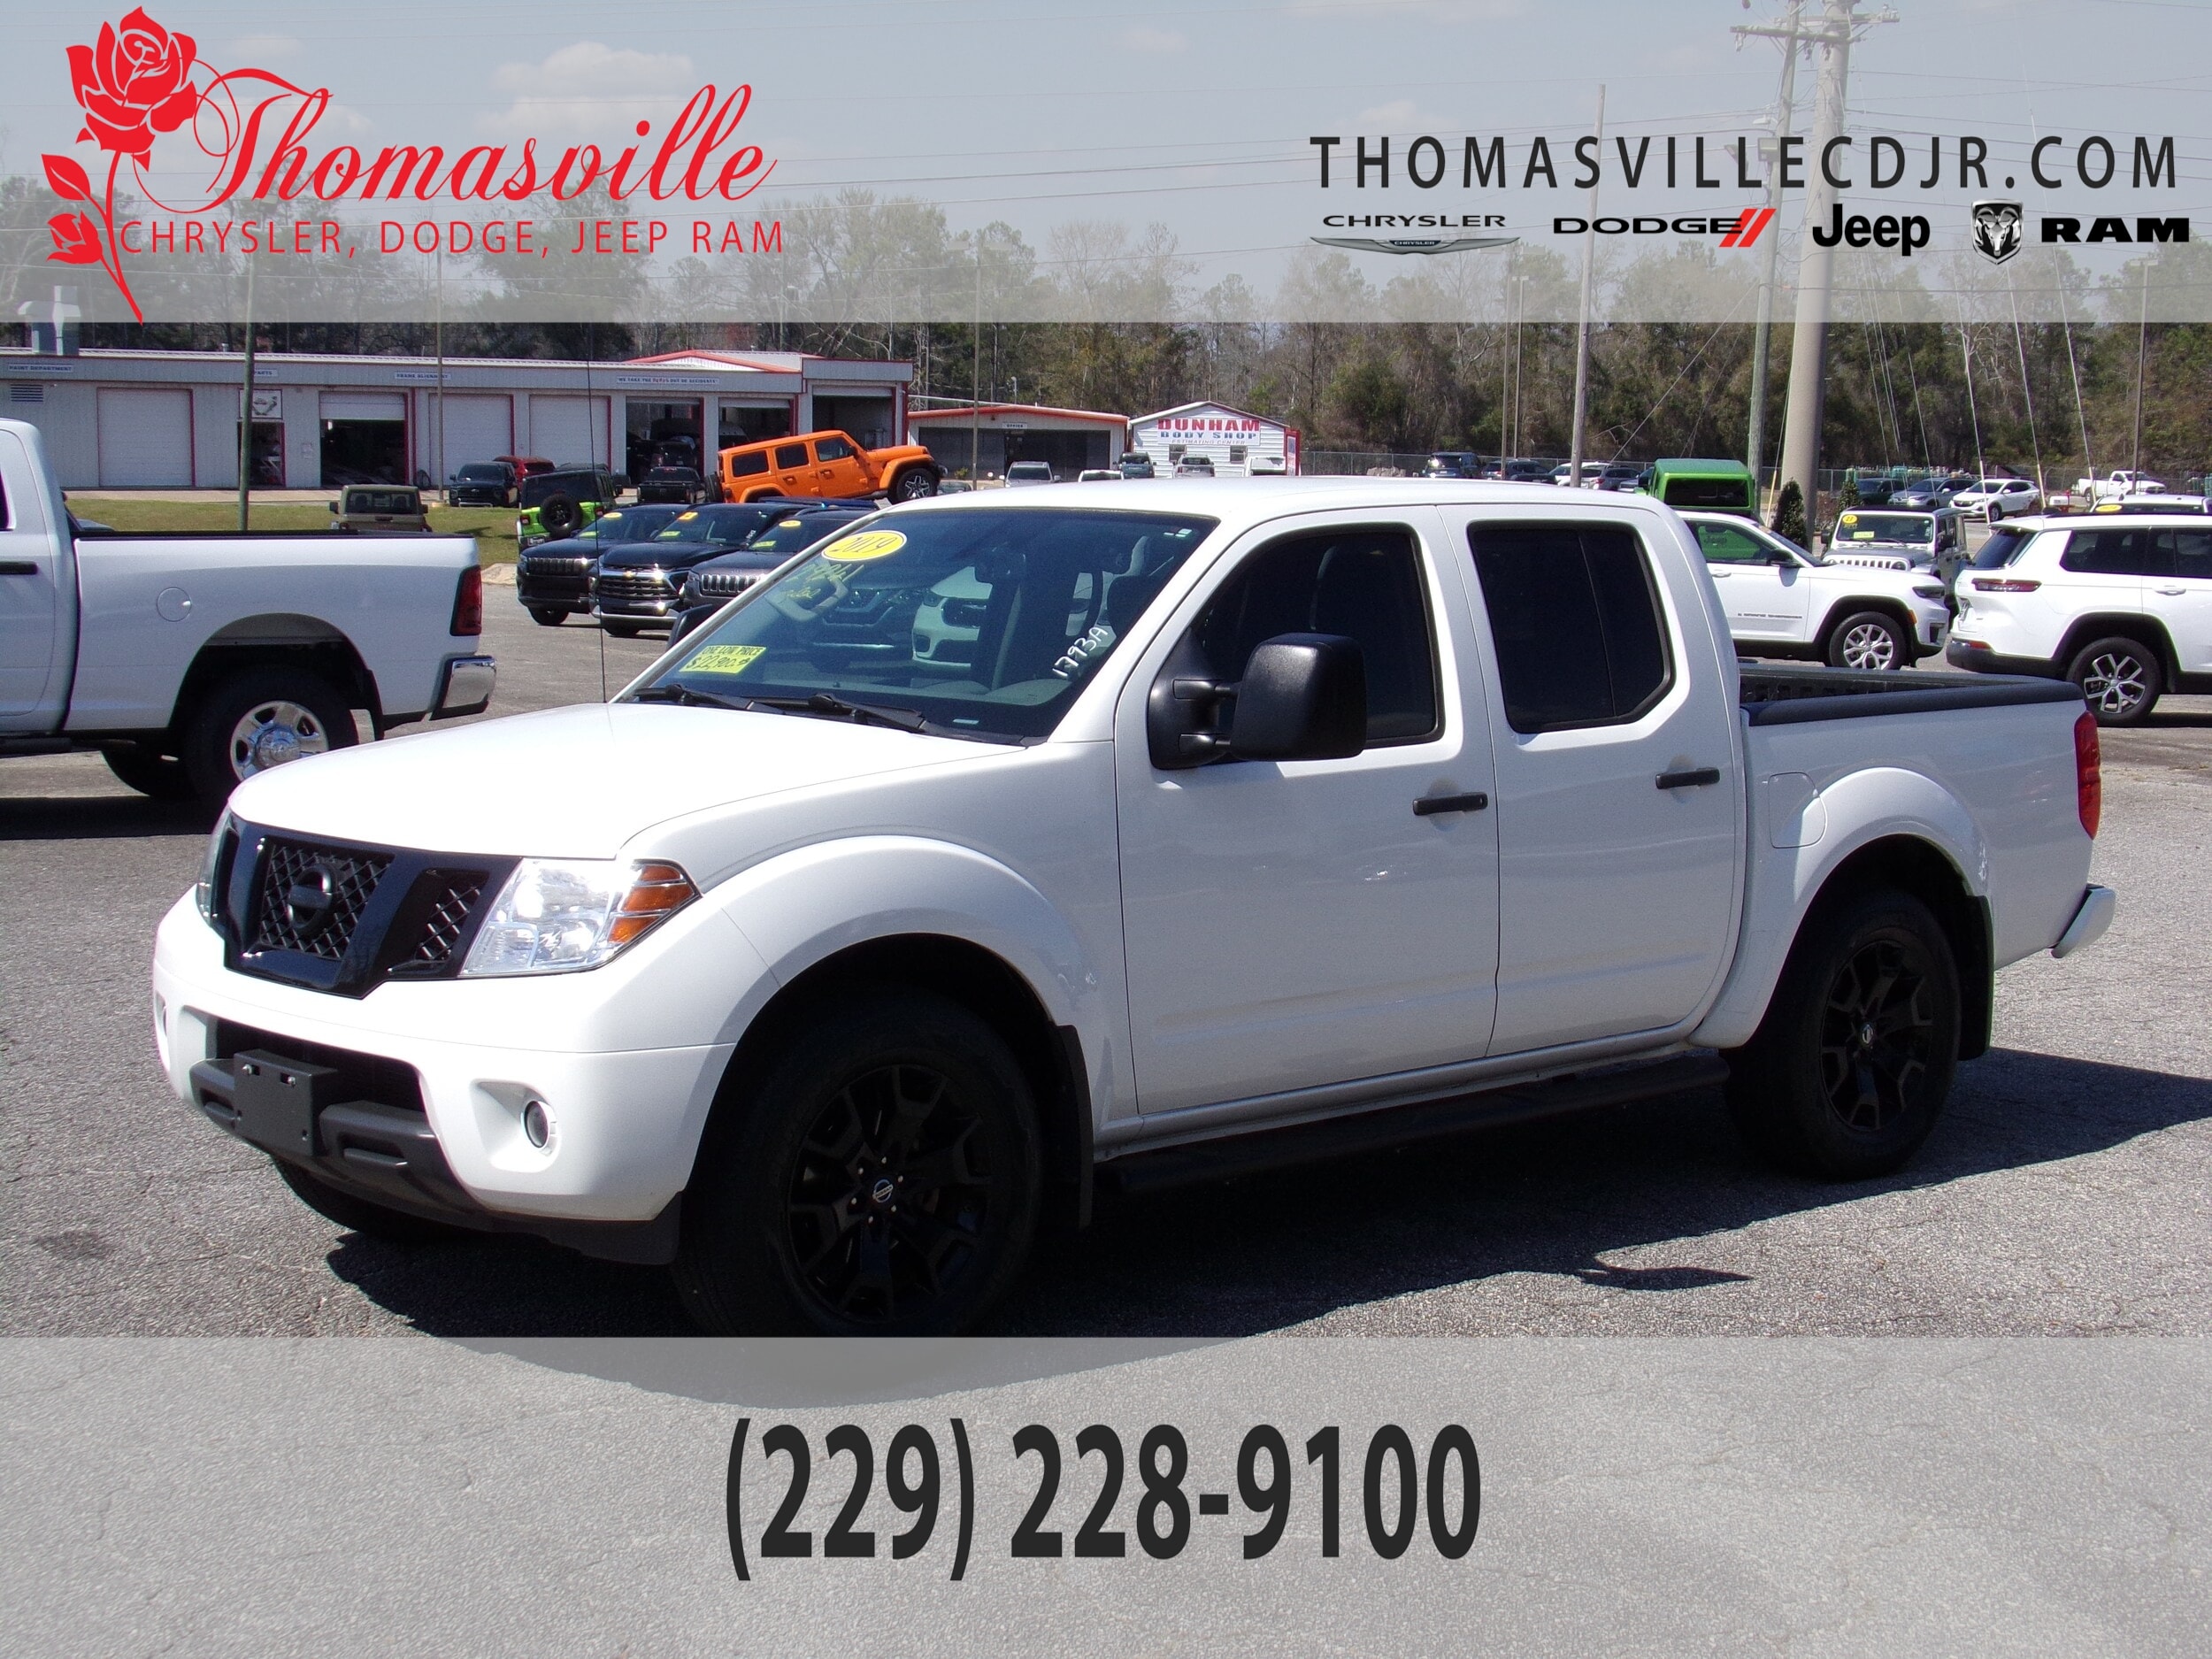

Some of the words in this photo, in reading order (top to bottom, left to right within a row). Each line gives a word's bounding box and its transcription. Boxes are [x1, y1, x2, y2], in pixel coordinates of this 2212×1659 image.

[1157, 419, 1260, 432] DUNHAM
[829, 536, 898, 554] 2019
[1052, 626, 1109, 677] 1793A
